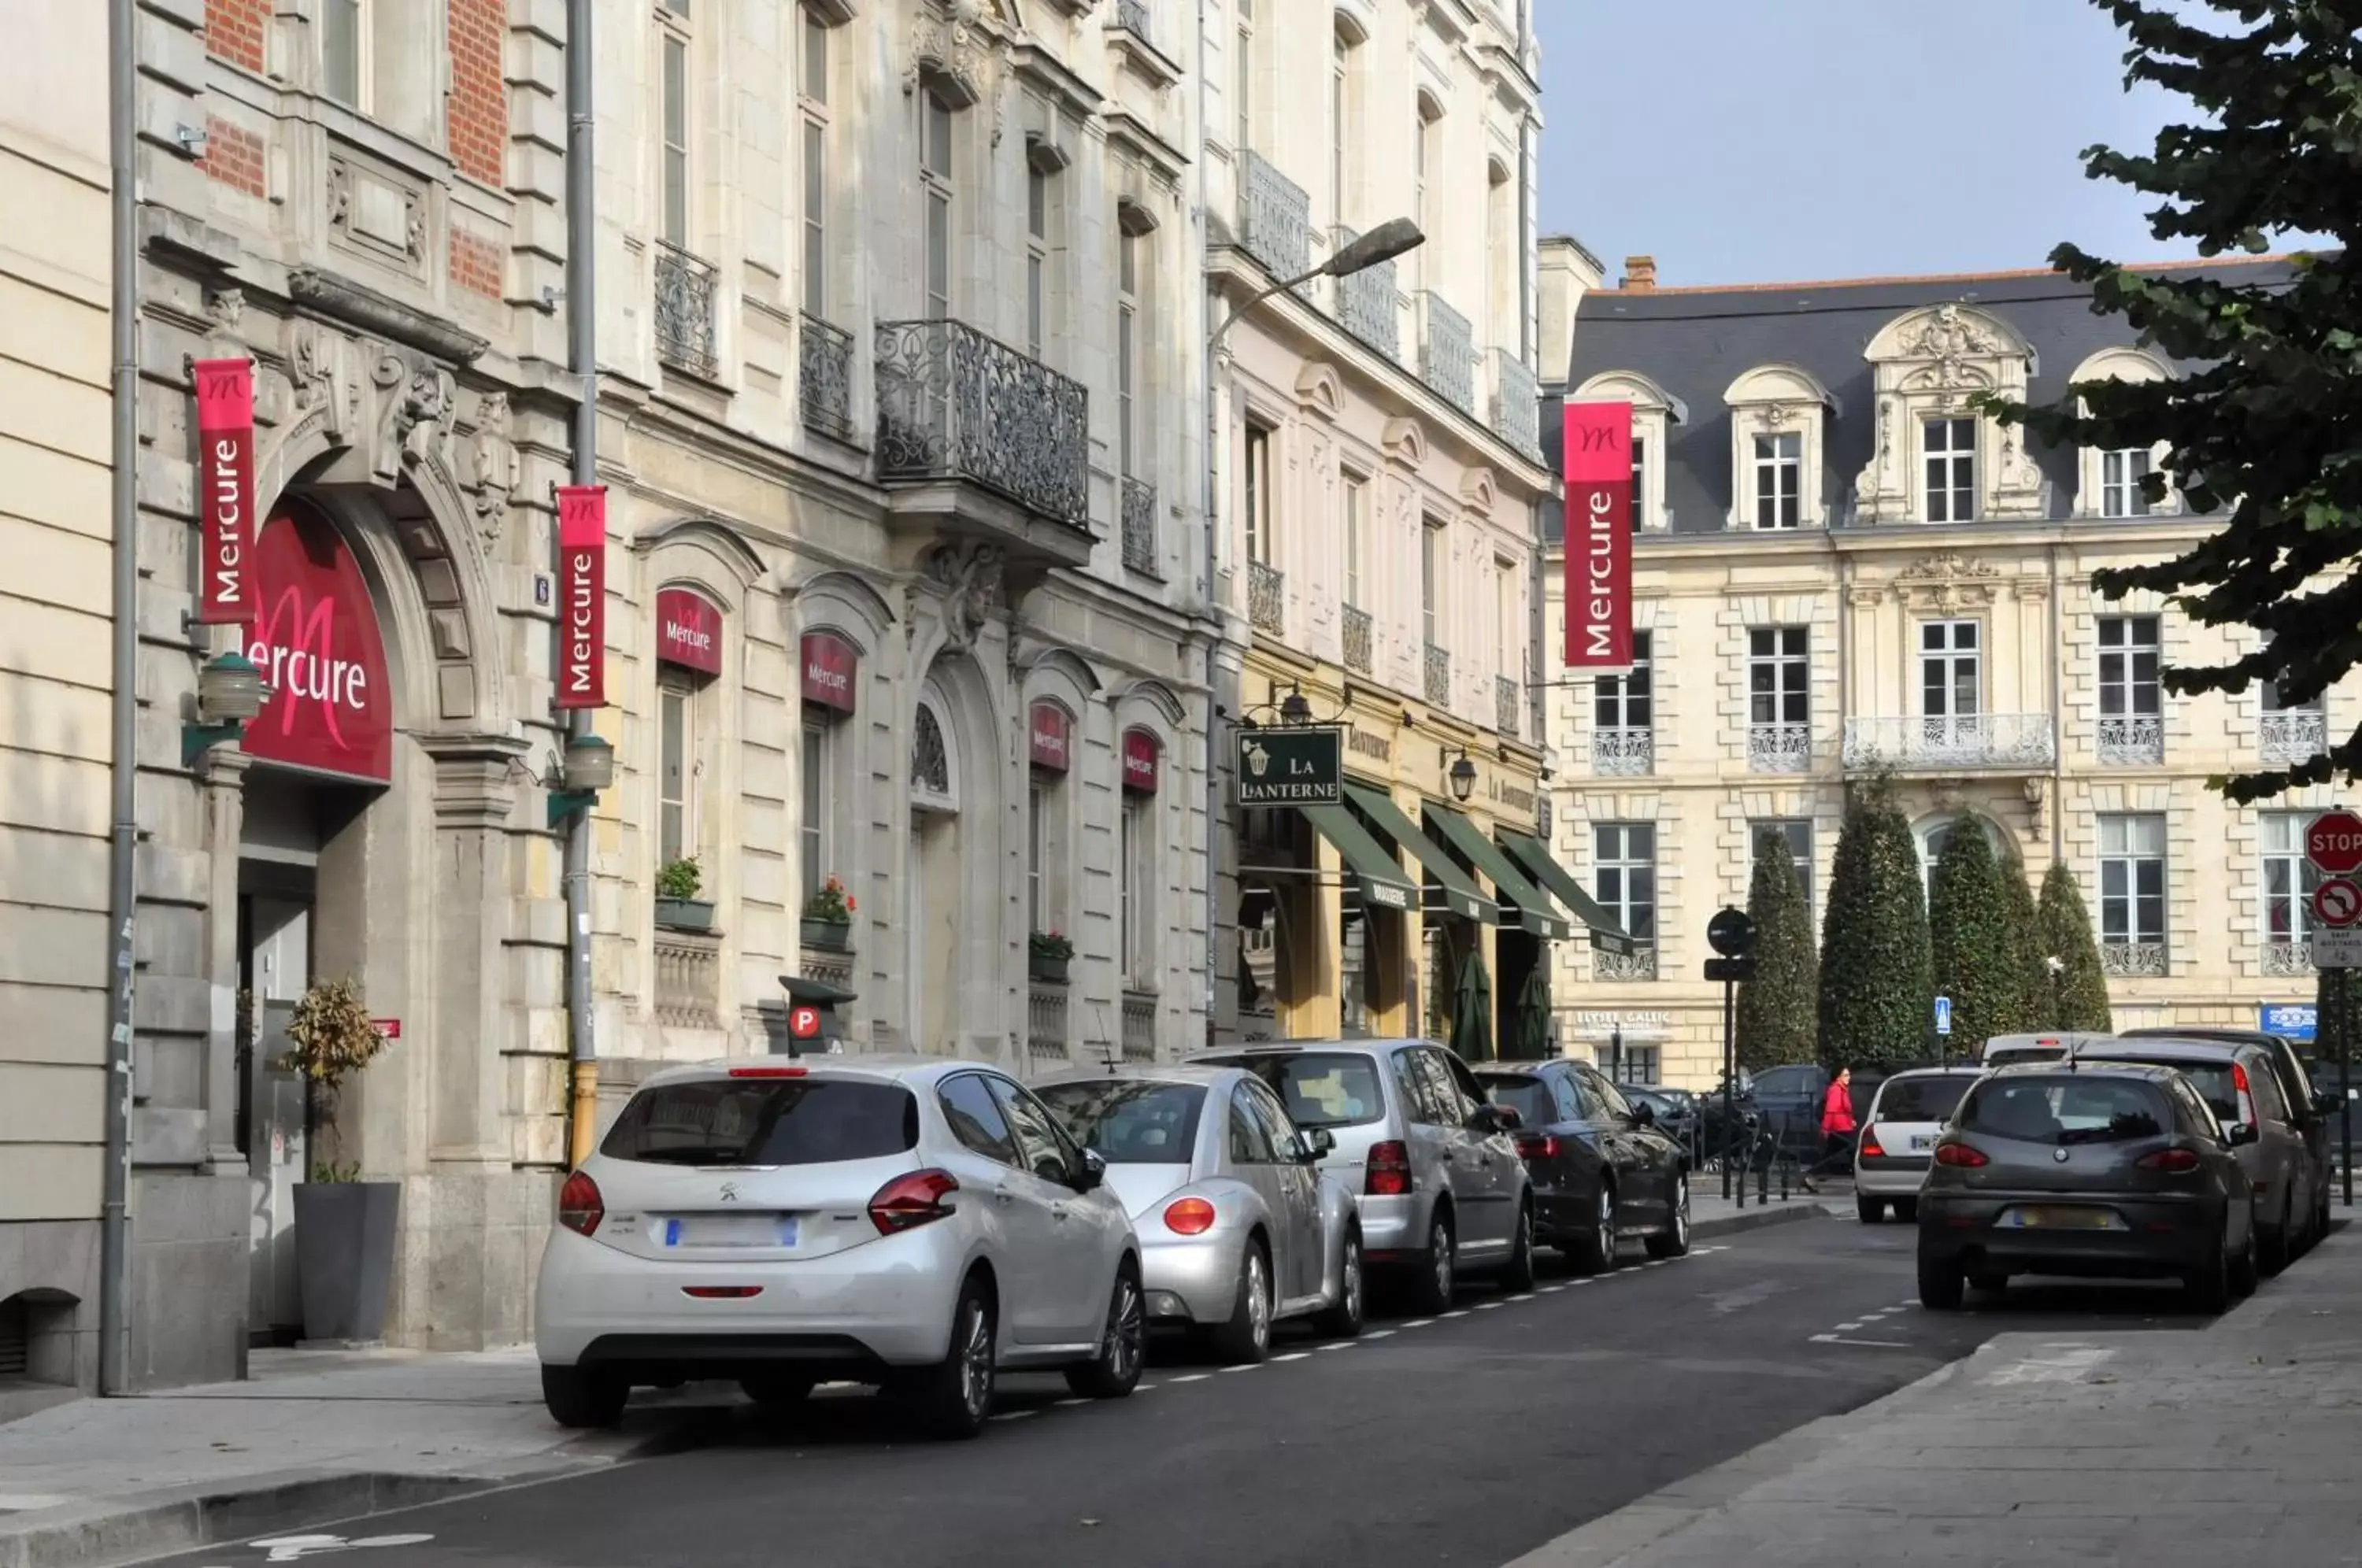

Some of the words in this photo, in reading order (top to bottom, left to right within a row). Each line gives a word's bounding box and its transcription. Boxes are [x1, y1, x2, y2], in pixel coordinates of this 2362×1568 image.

[217, 440, 240, 603] Mercure
[1586, 491, 1612, 657] Mercure
[570, 553, 592, 692] Mercure
[666, 619, 711, 650] Mercure
[239, 627, 367, 708] ercure
[808, 663, 848, 690] Mercure
[1290, 757, 1315, 775] LA
[1242, 782, 1337, 799] LANTERNE
[2312, 834, 2362, 852] STOP
[798, 1011, 813, 1031] P
